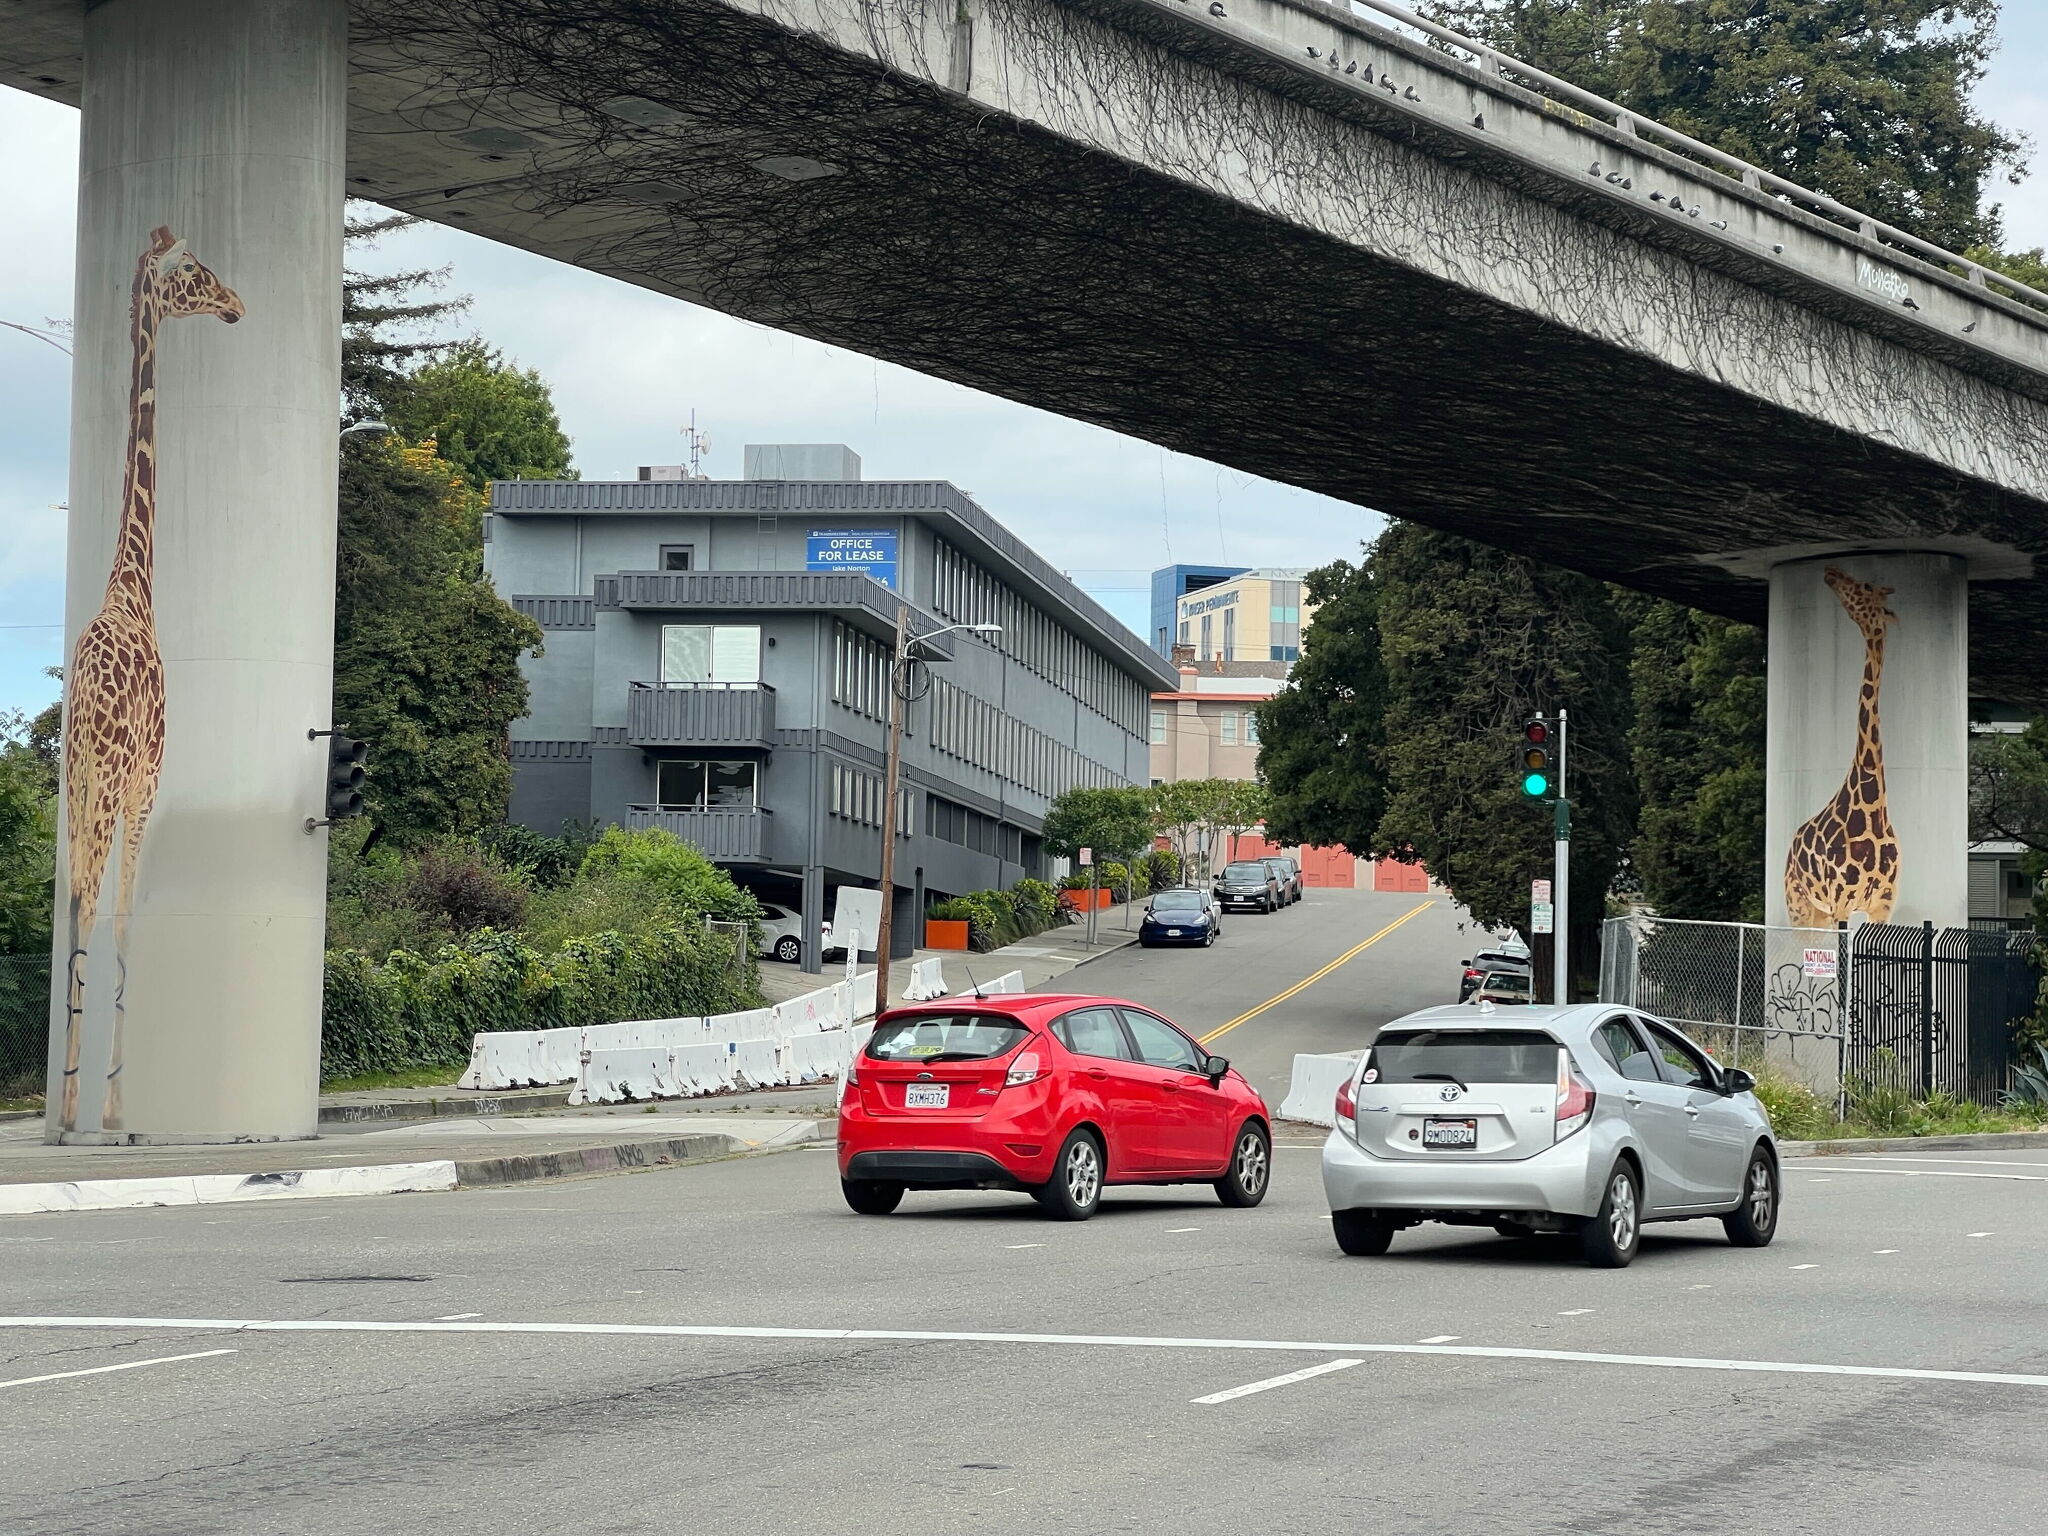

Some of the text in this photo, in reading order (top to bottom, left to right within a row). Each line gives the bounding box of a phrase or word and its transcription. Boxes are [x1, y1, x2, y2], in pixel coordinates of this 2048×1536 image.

[830, 539, 873, 549] OFFICE
[818, 551, 884, 561] FOR LEASE
[1804, 950, 1835, 963] NATIONAL
